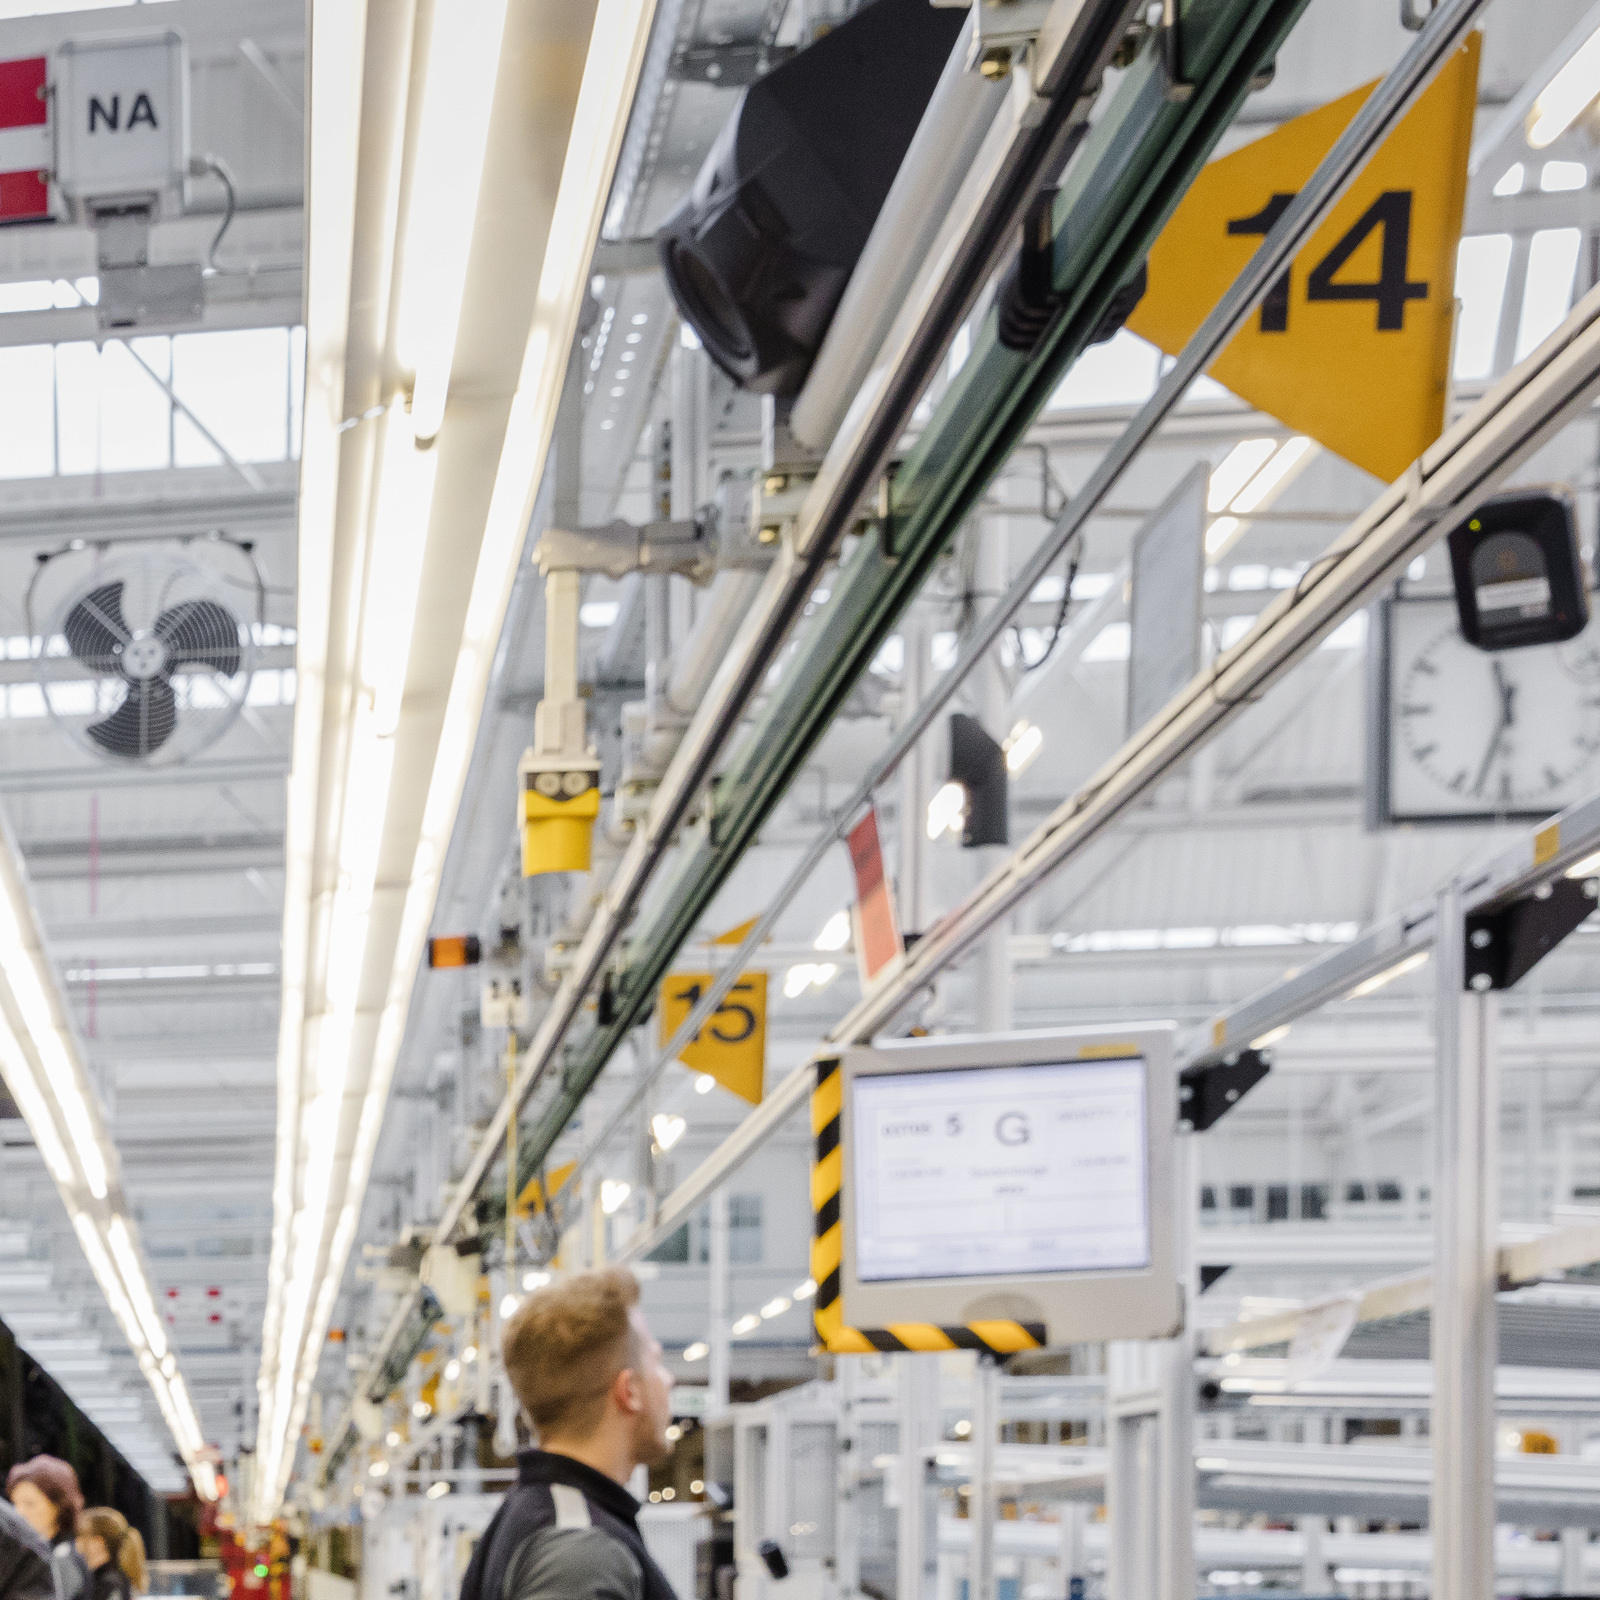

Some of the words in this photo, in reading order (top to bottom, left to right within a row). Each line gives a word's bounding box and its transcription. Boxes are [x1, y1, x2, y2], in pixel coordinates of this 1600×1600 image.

[89, 92, 157, 132] NA
[1226, 189, 1429, 334] 14
[996, 1111, 1030, 1147] G
